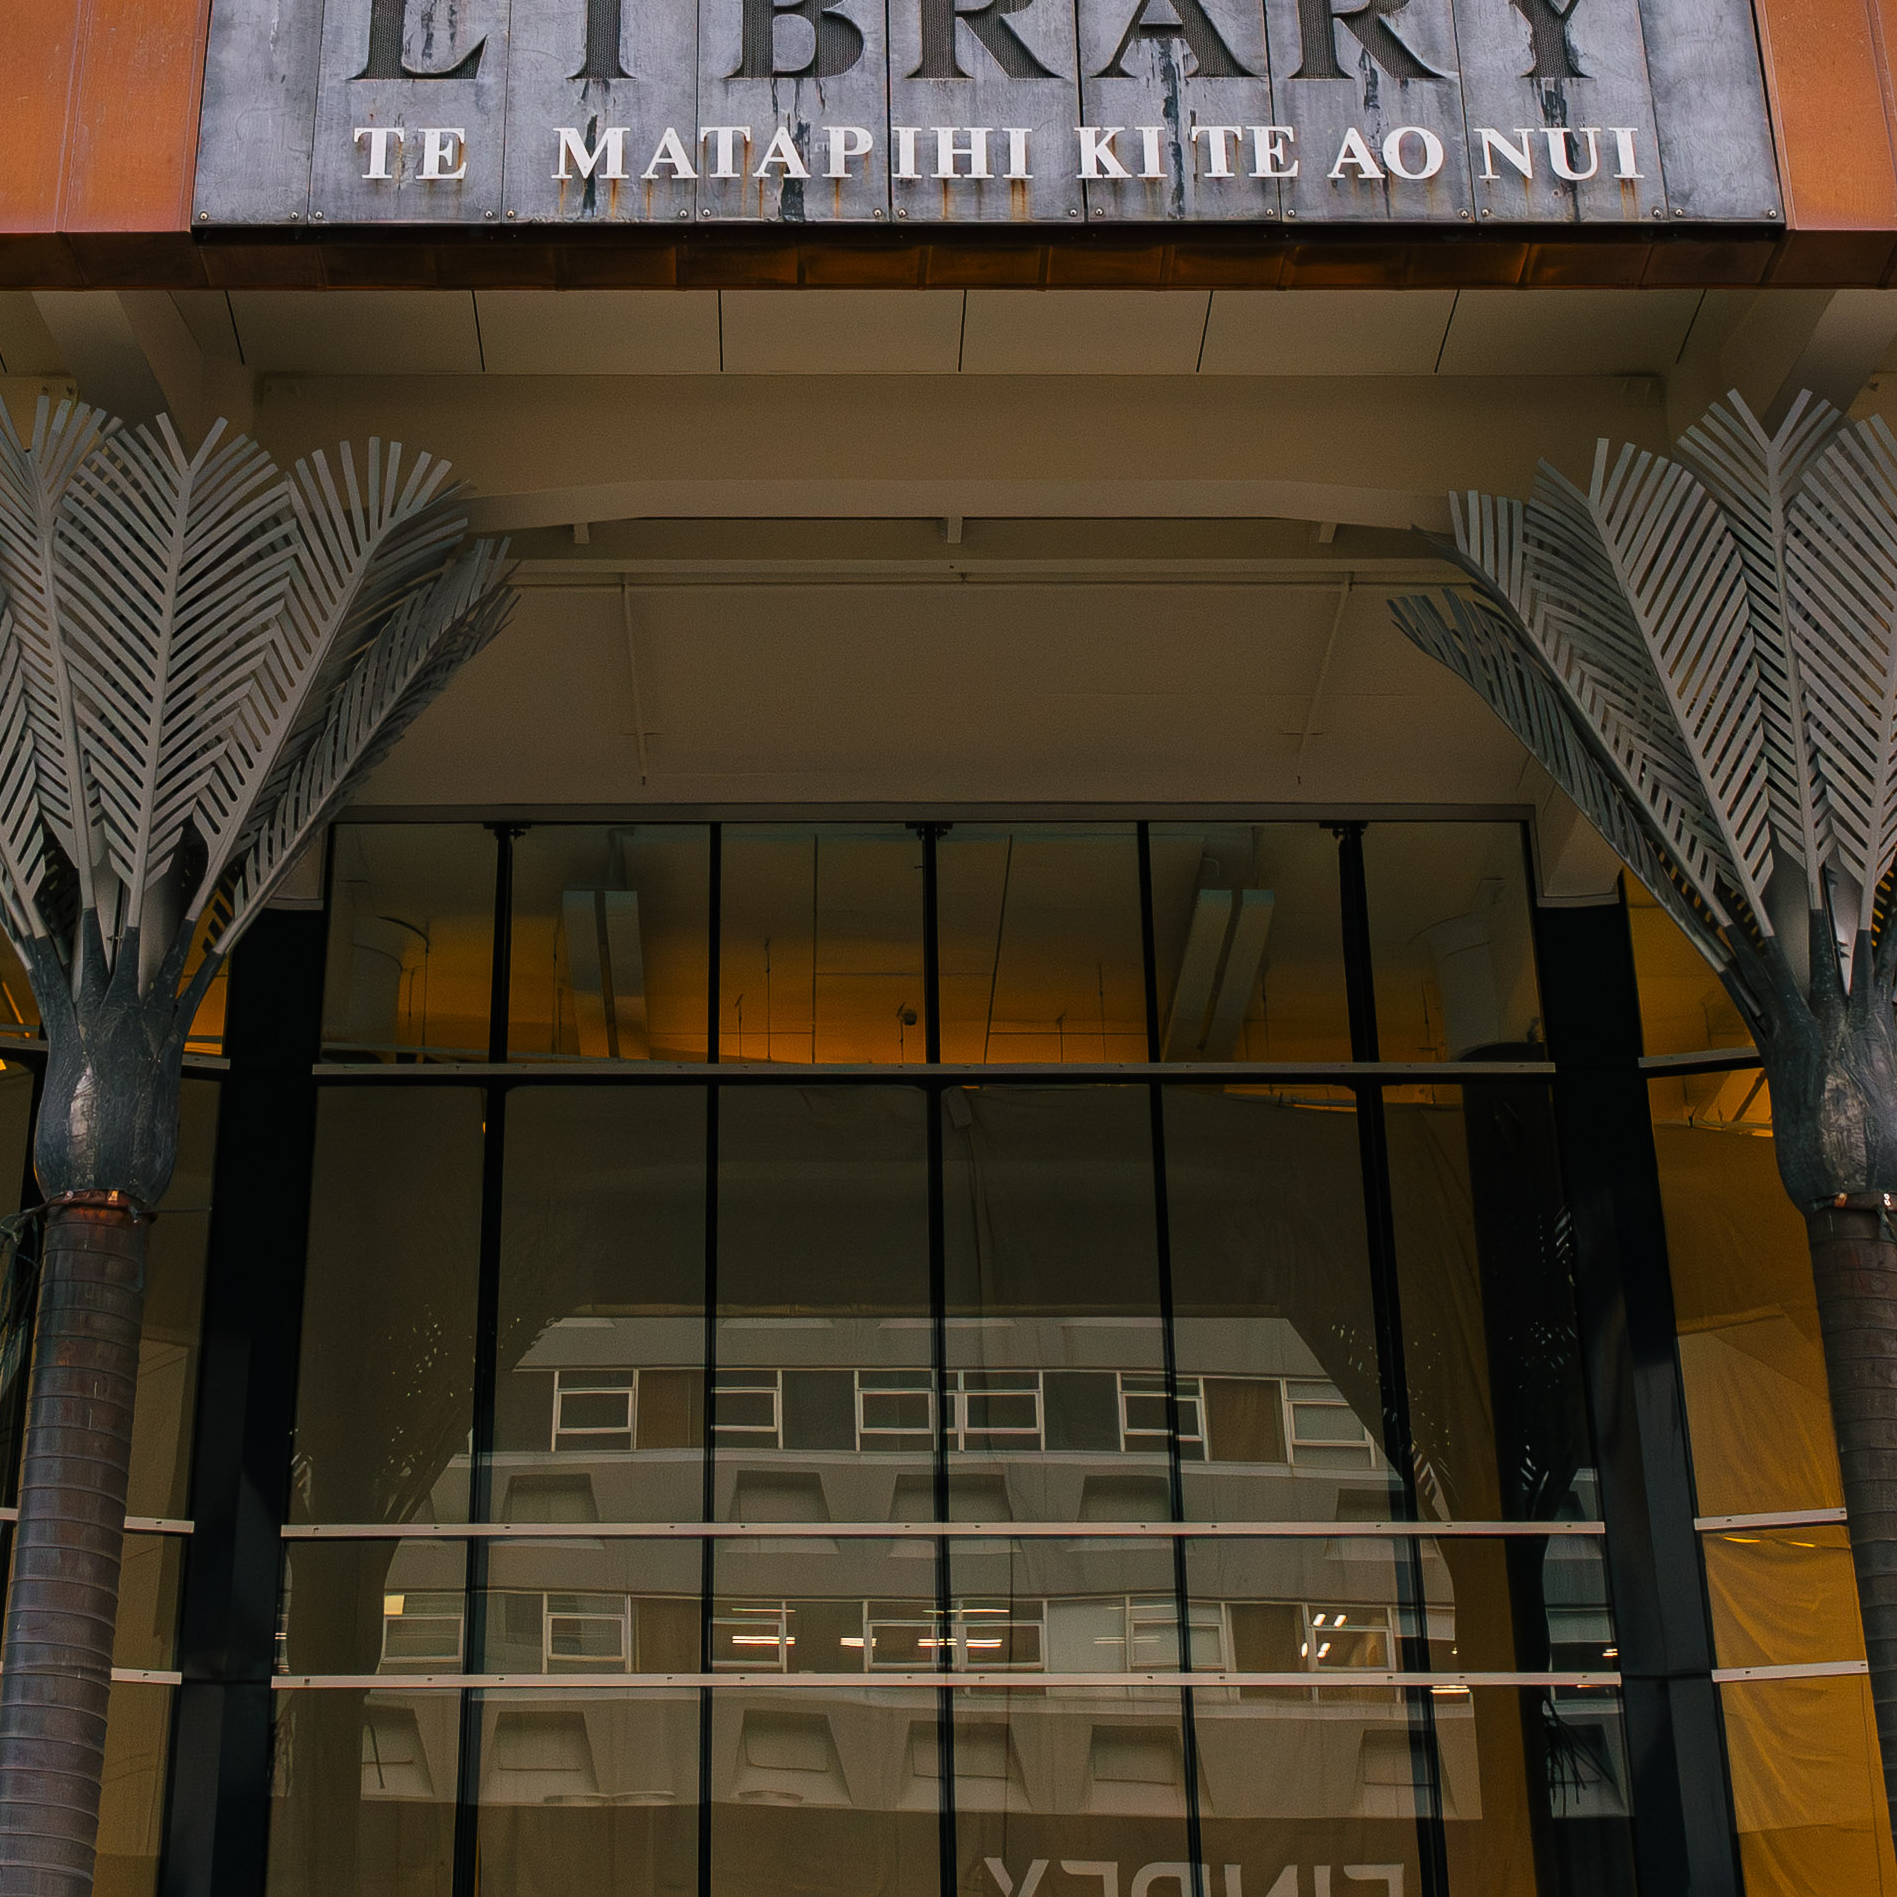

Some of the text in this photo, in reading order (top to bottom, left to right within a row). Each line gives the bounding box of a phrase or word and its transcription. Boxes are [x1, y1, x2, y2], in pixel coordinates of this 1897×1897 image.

[353, 125, 1644, 181] TE MATAPIHI KI TE AO NUI
